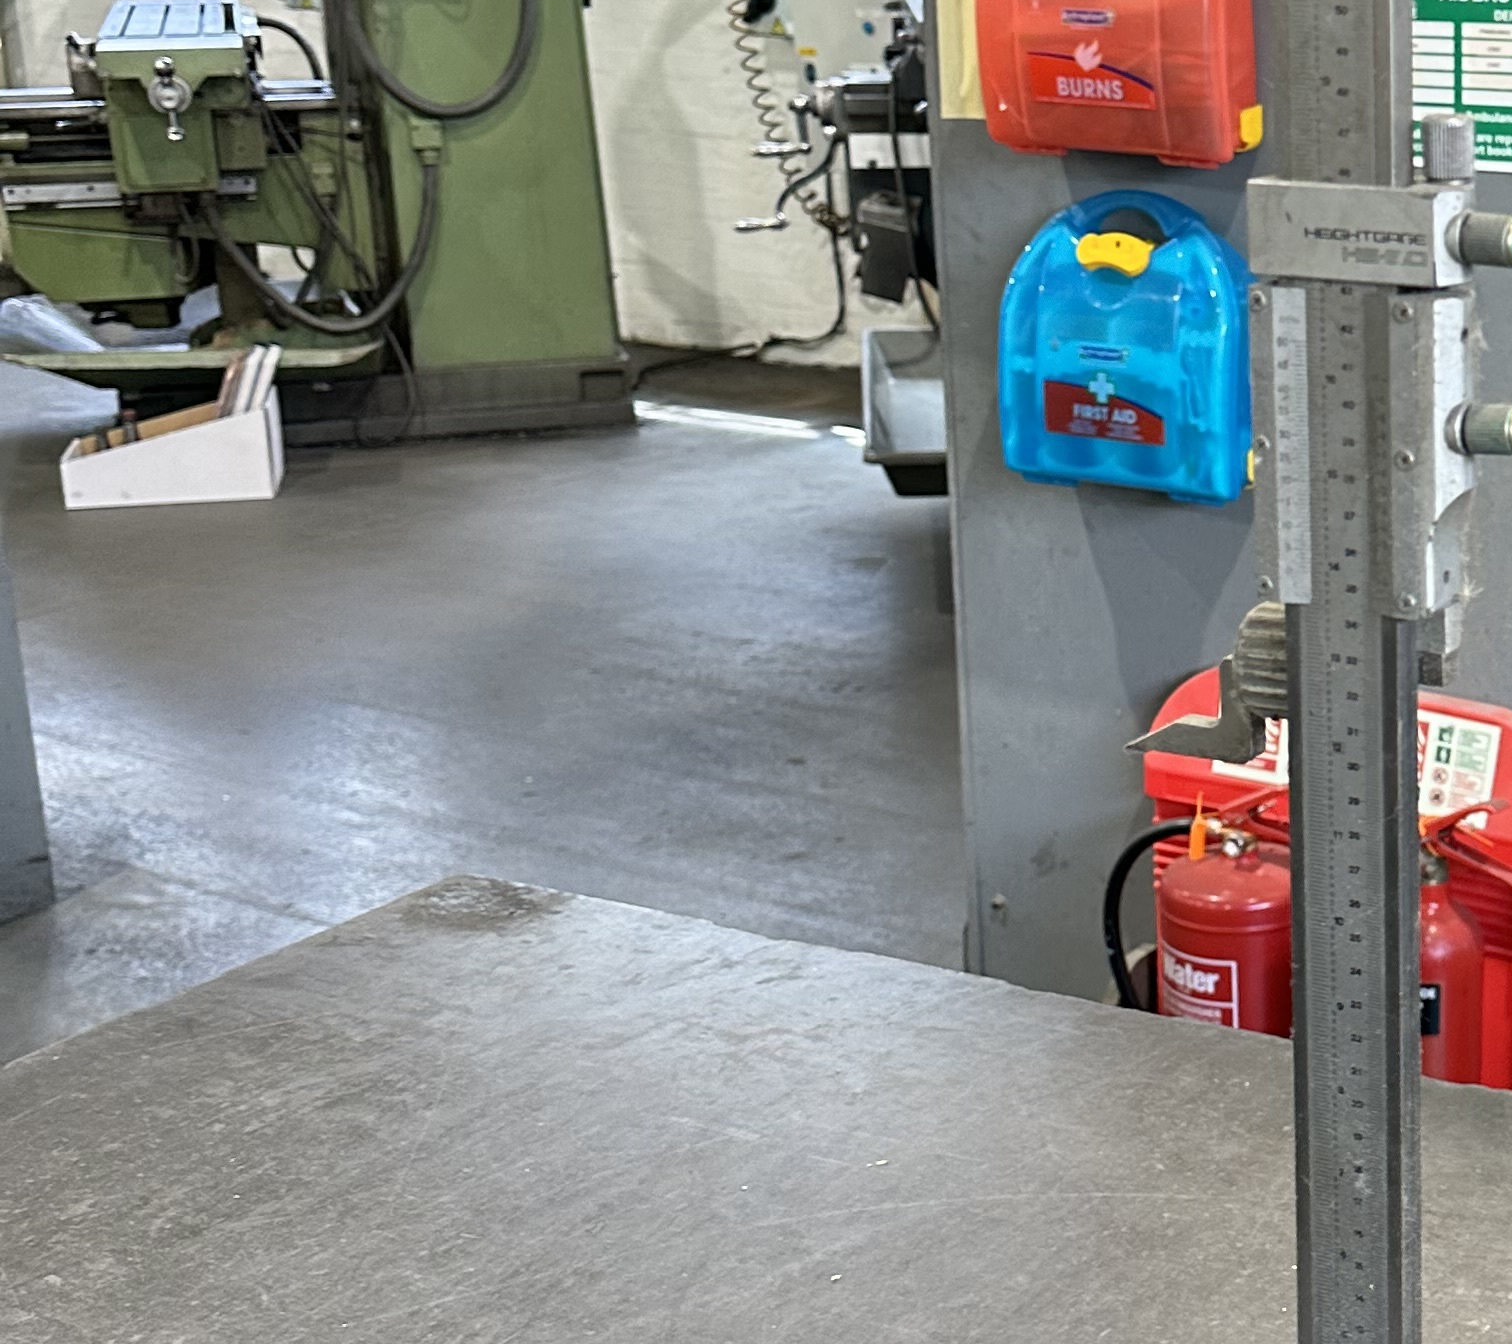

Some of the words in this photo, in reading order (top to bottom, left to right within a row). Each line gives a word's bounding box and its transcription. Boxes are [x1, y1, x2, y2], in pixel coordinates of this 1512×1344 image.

[1056, 75, 1124, 101] BURNS
[1072, 403, 1108, 421] FIRST
[1110, 407, 1138, 425] AID
